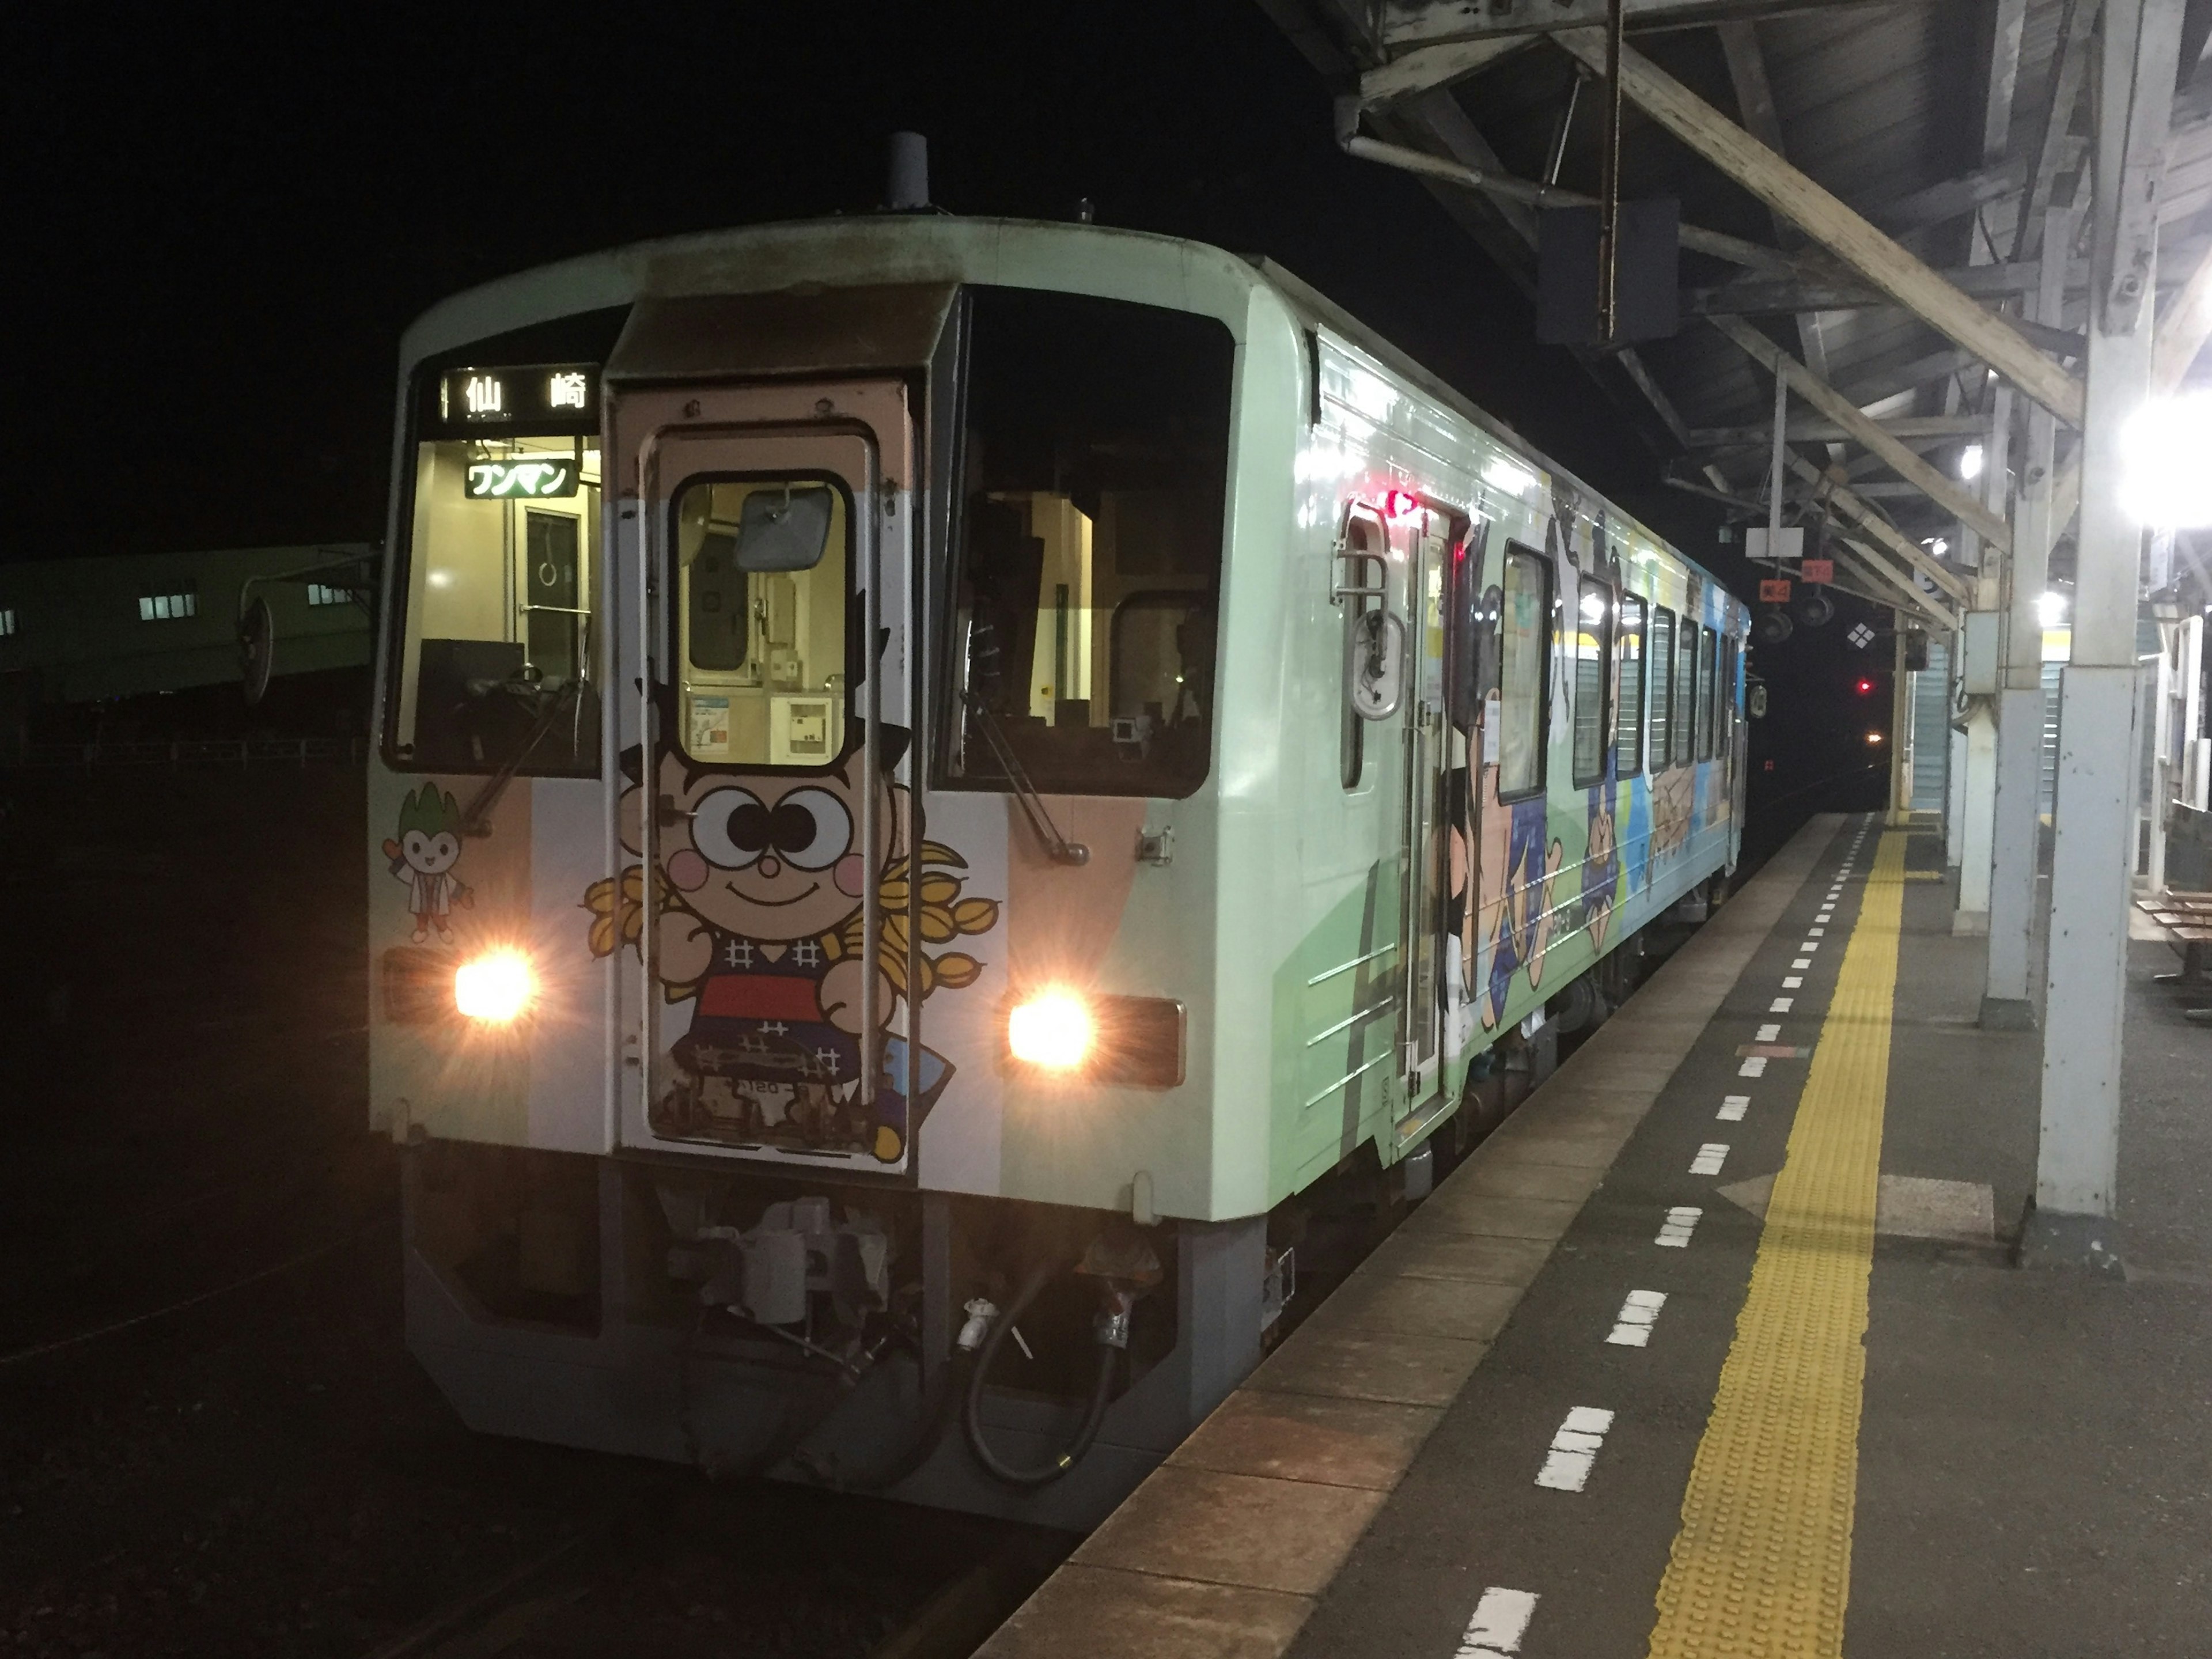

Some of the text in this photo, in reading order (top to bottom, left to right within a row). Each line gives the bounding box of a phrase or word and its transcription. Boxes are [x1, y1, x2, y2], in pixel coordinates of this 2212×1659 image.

[465, 372, 586, 413] 仙崎
[468, 463, 567, 496] ワンマン
